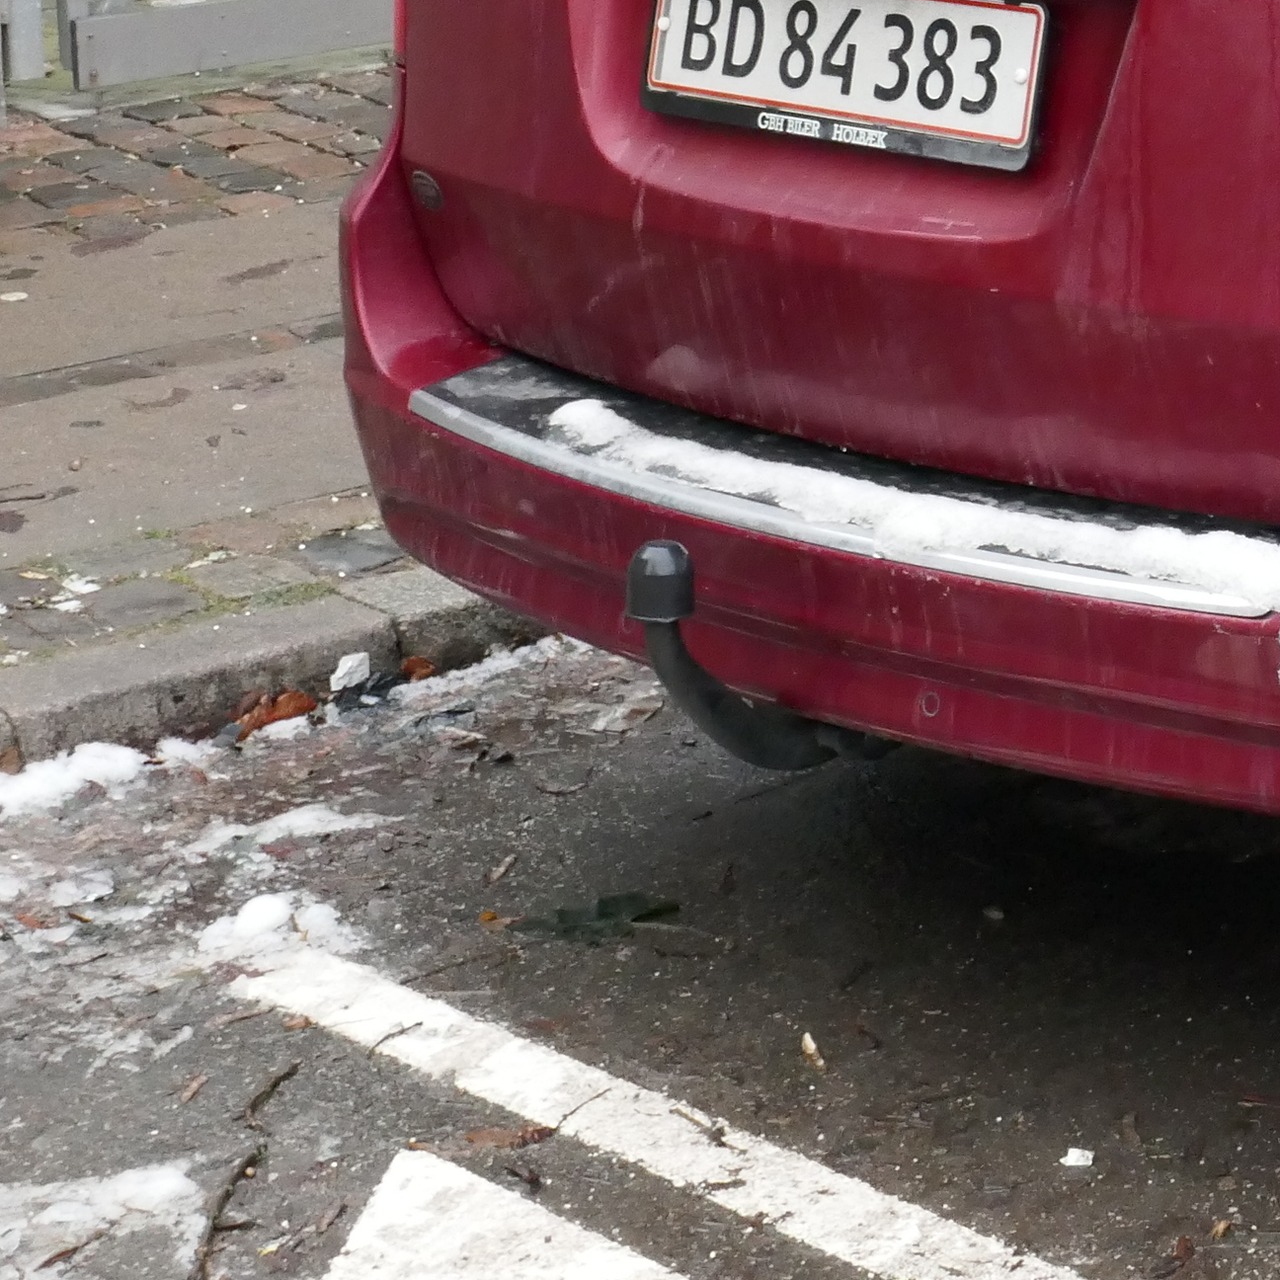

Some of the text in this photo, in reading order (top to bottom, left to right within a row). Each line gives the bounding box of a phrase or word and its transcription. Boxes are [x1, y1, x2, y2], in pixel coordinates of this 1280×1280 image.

[779, 0, 861, 96] 84
[874, 13, 1001, 115] 383
[757, 112, 888, 149] GBH BILER HOLBÆK
